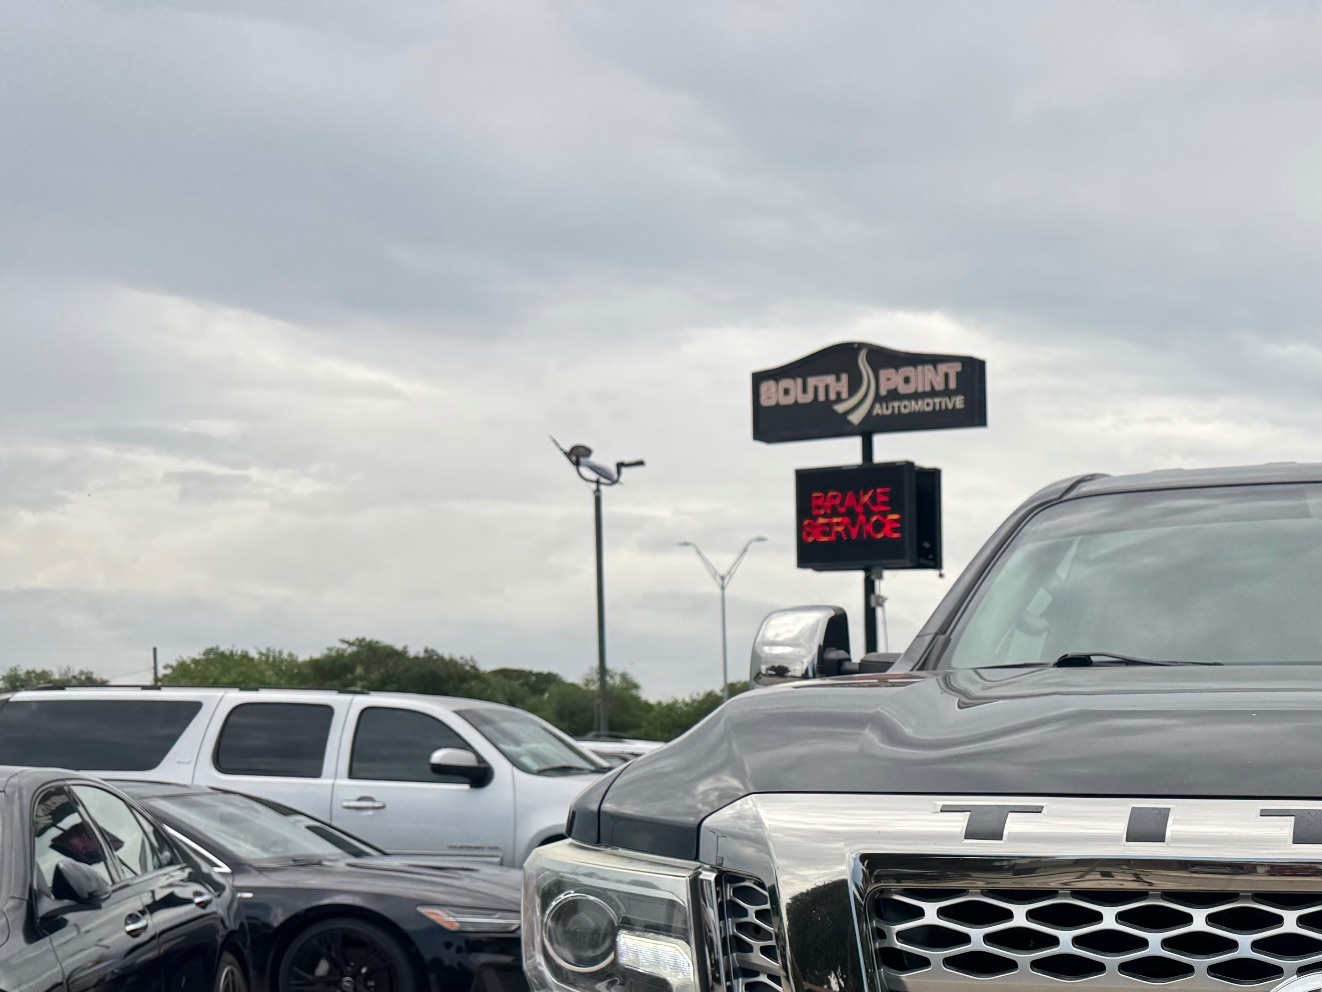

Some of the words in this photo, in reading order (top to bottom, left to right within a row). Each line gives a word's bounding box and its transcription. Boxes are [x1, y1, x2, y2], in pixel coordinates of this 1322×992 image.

[760, 374, 848, 406] SOUTH
[880, 362, 962, 395] POINT
[872, 395, 965, 417] AUTOMOTIVE
[811, 487, 892, 516] BRAKE
[802, 514, 902, 543] SERVICE
